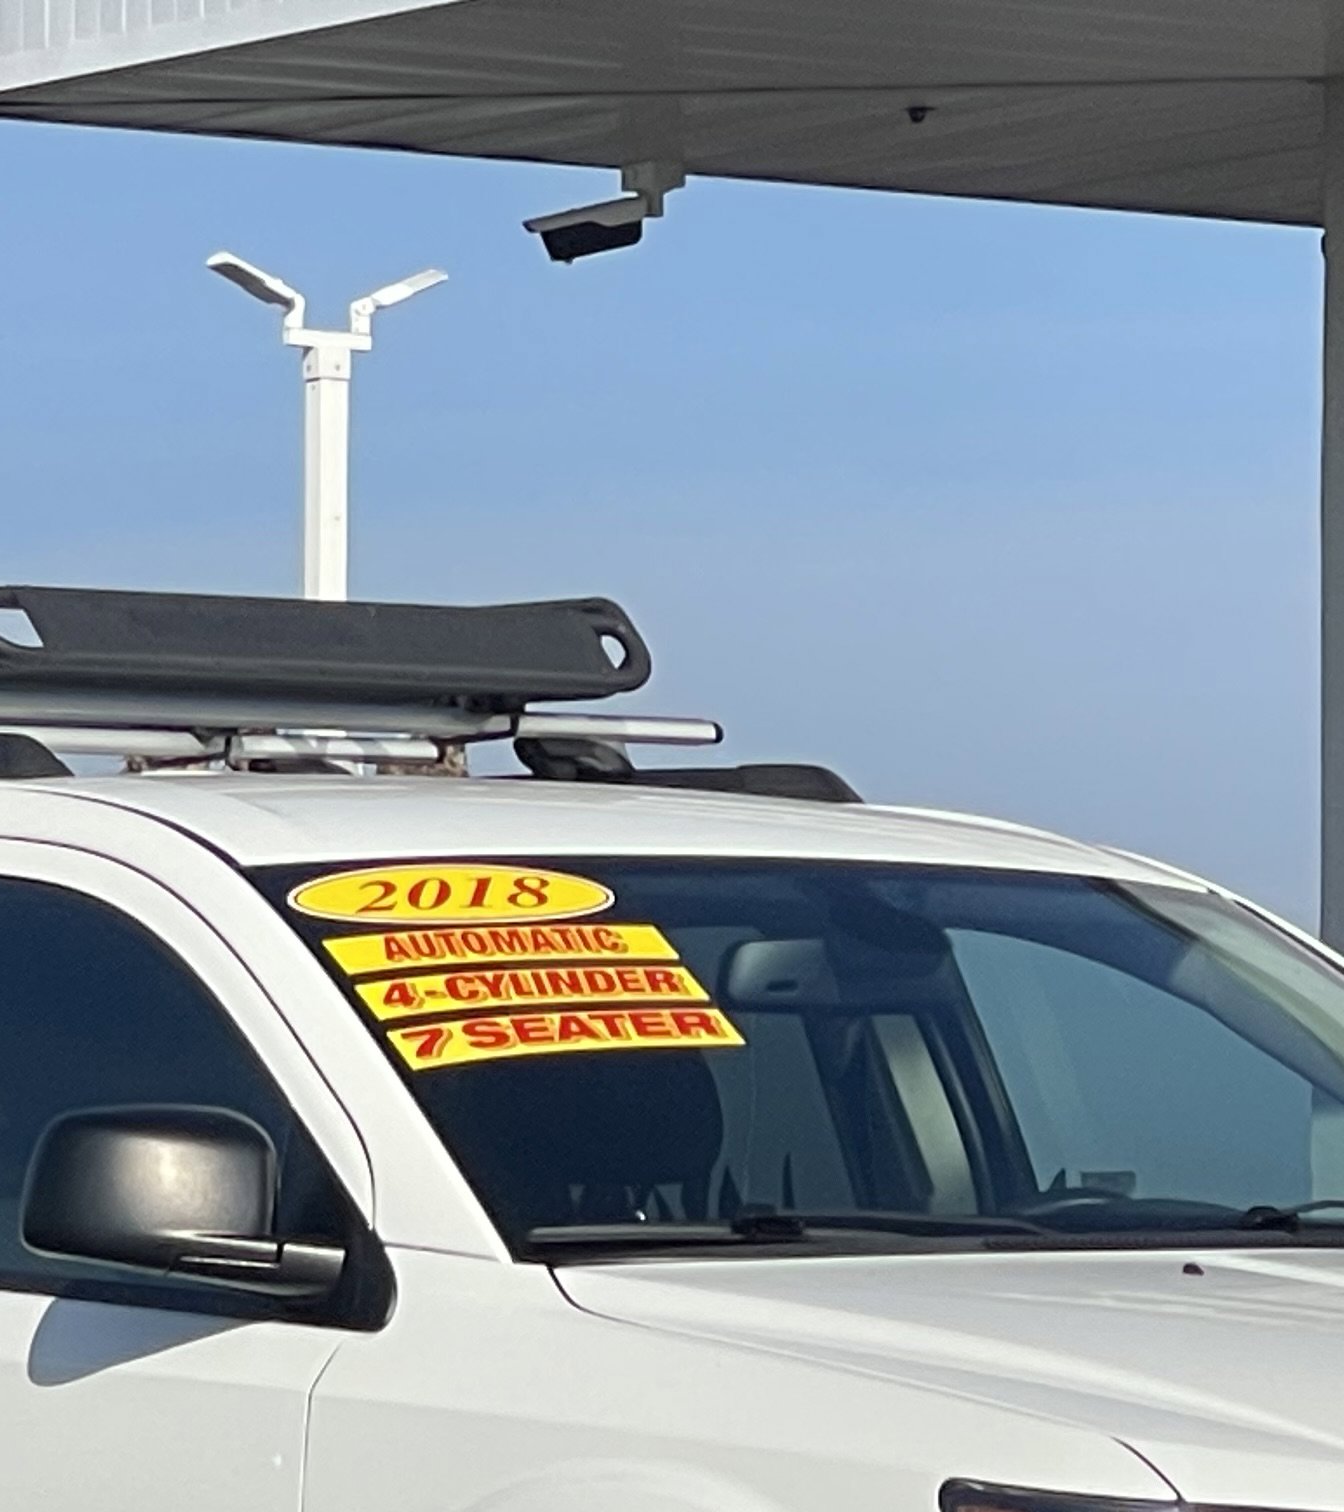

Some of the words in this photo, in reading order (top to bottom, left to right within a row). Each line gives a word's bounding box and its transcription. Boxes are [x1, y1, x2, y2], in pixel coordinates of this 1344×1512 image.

[355, 876, 550, 915] 2018
[383, 926, 628, 962] AUTOMATIC
[383, 969, 684, 1010] 4-CYLINDER
[401, 1026, 453, 1061] 7
[461, 1010, 723, 1050] SEATER
